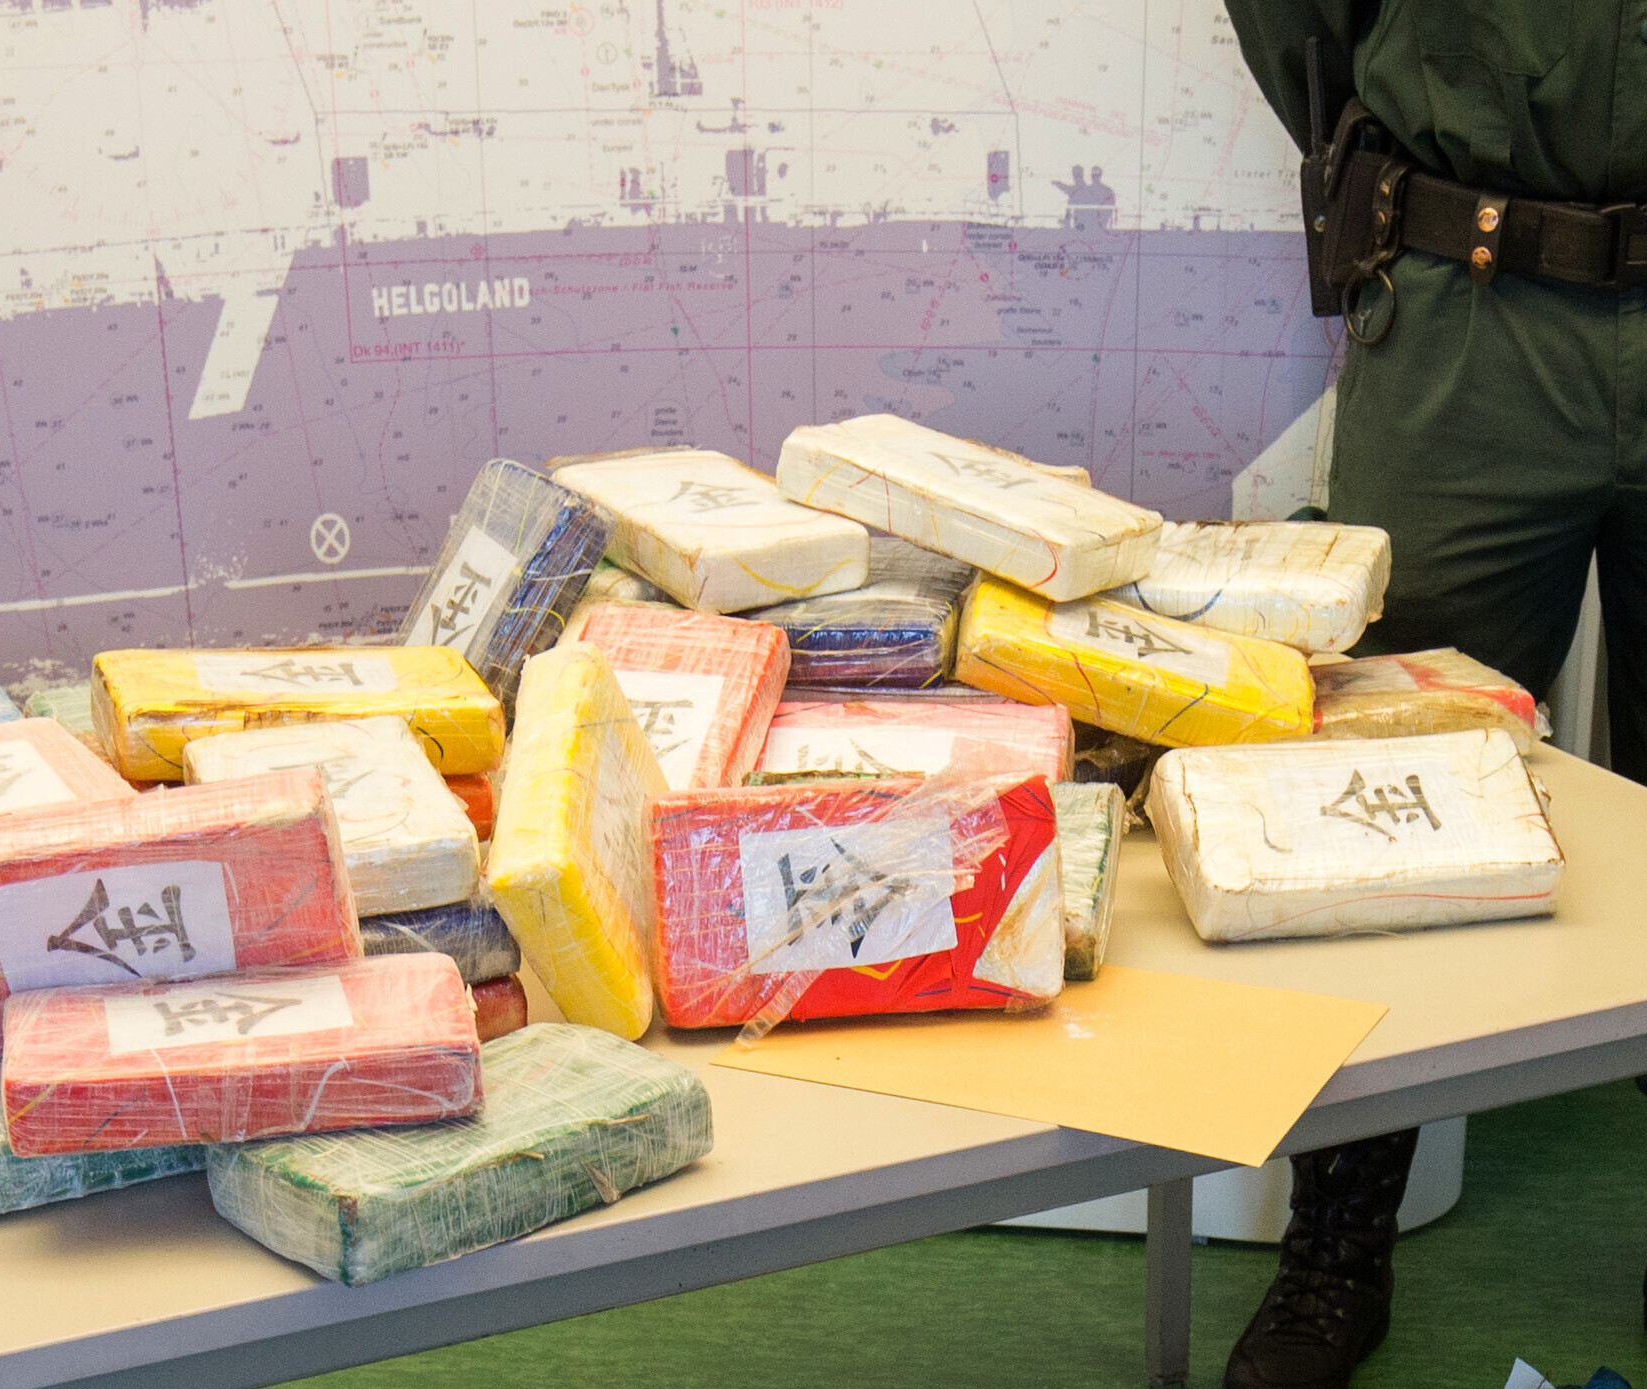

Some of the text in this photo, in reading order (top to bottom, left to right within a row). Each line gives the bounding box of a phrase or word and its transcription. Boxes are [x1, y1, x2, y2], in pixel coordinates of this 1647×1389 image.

[372, 278, 531, 318] HELGOLAND
[353, 344, 370, 356] Dk
[929, 451, 1039, 491] 金
[669, 479, 760, 513] 金
[431, 560, 492, 646] 金
[1087, 610, 1192, 661] 金
[241, 660, 365, 686] 金
[1320, 769, 1441, 843] 金
[46, 877, 197, 978] 金
[154, 991, 302, 1036] 金
